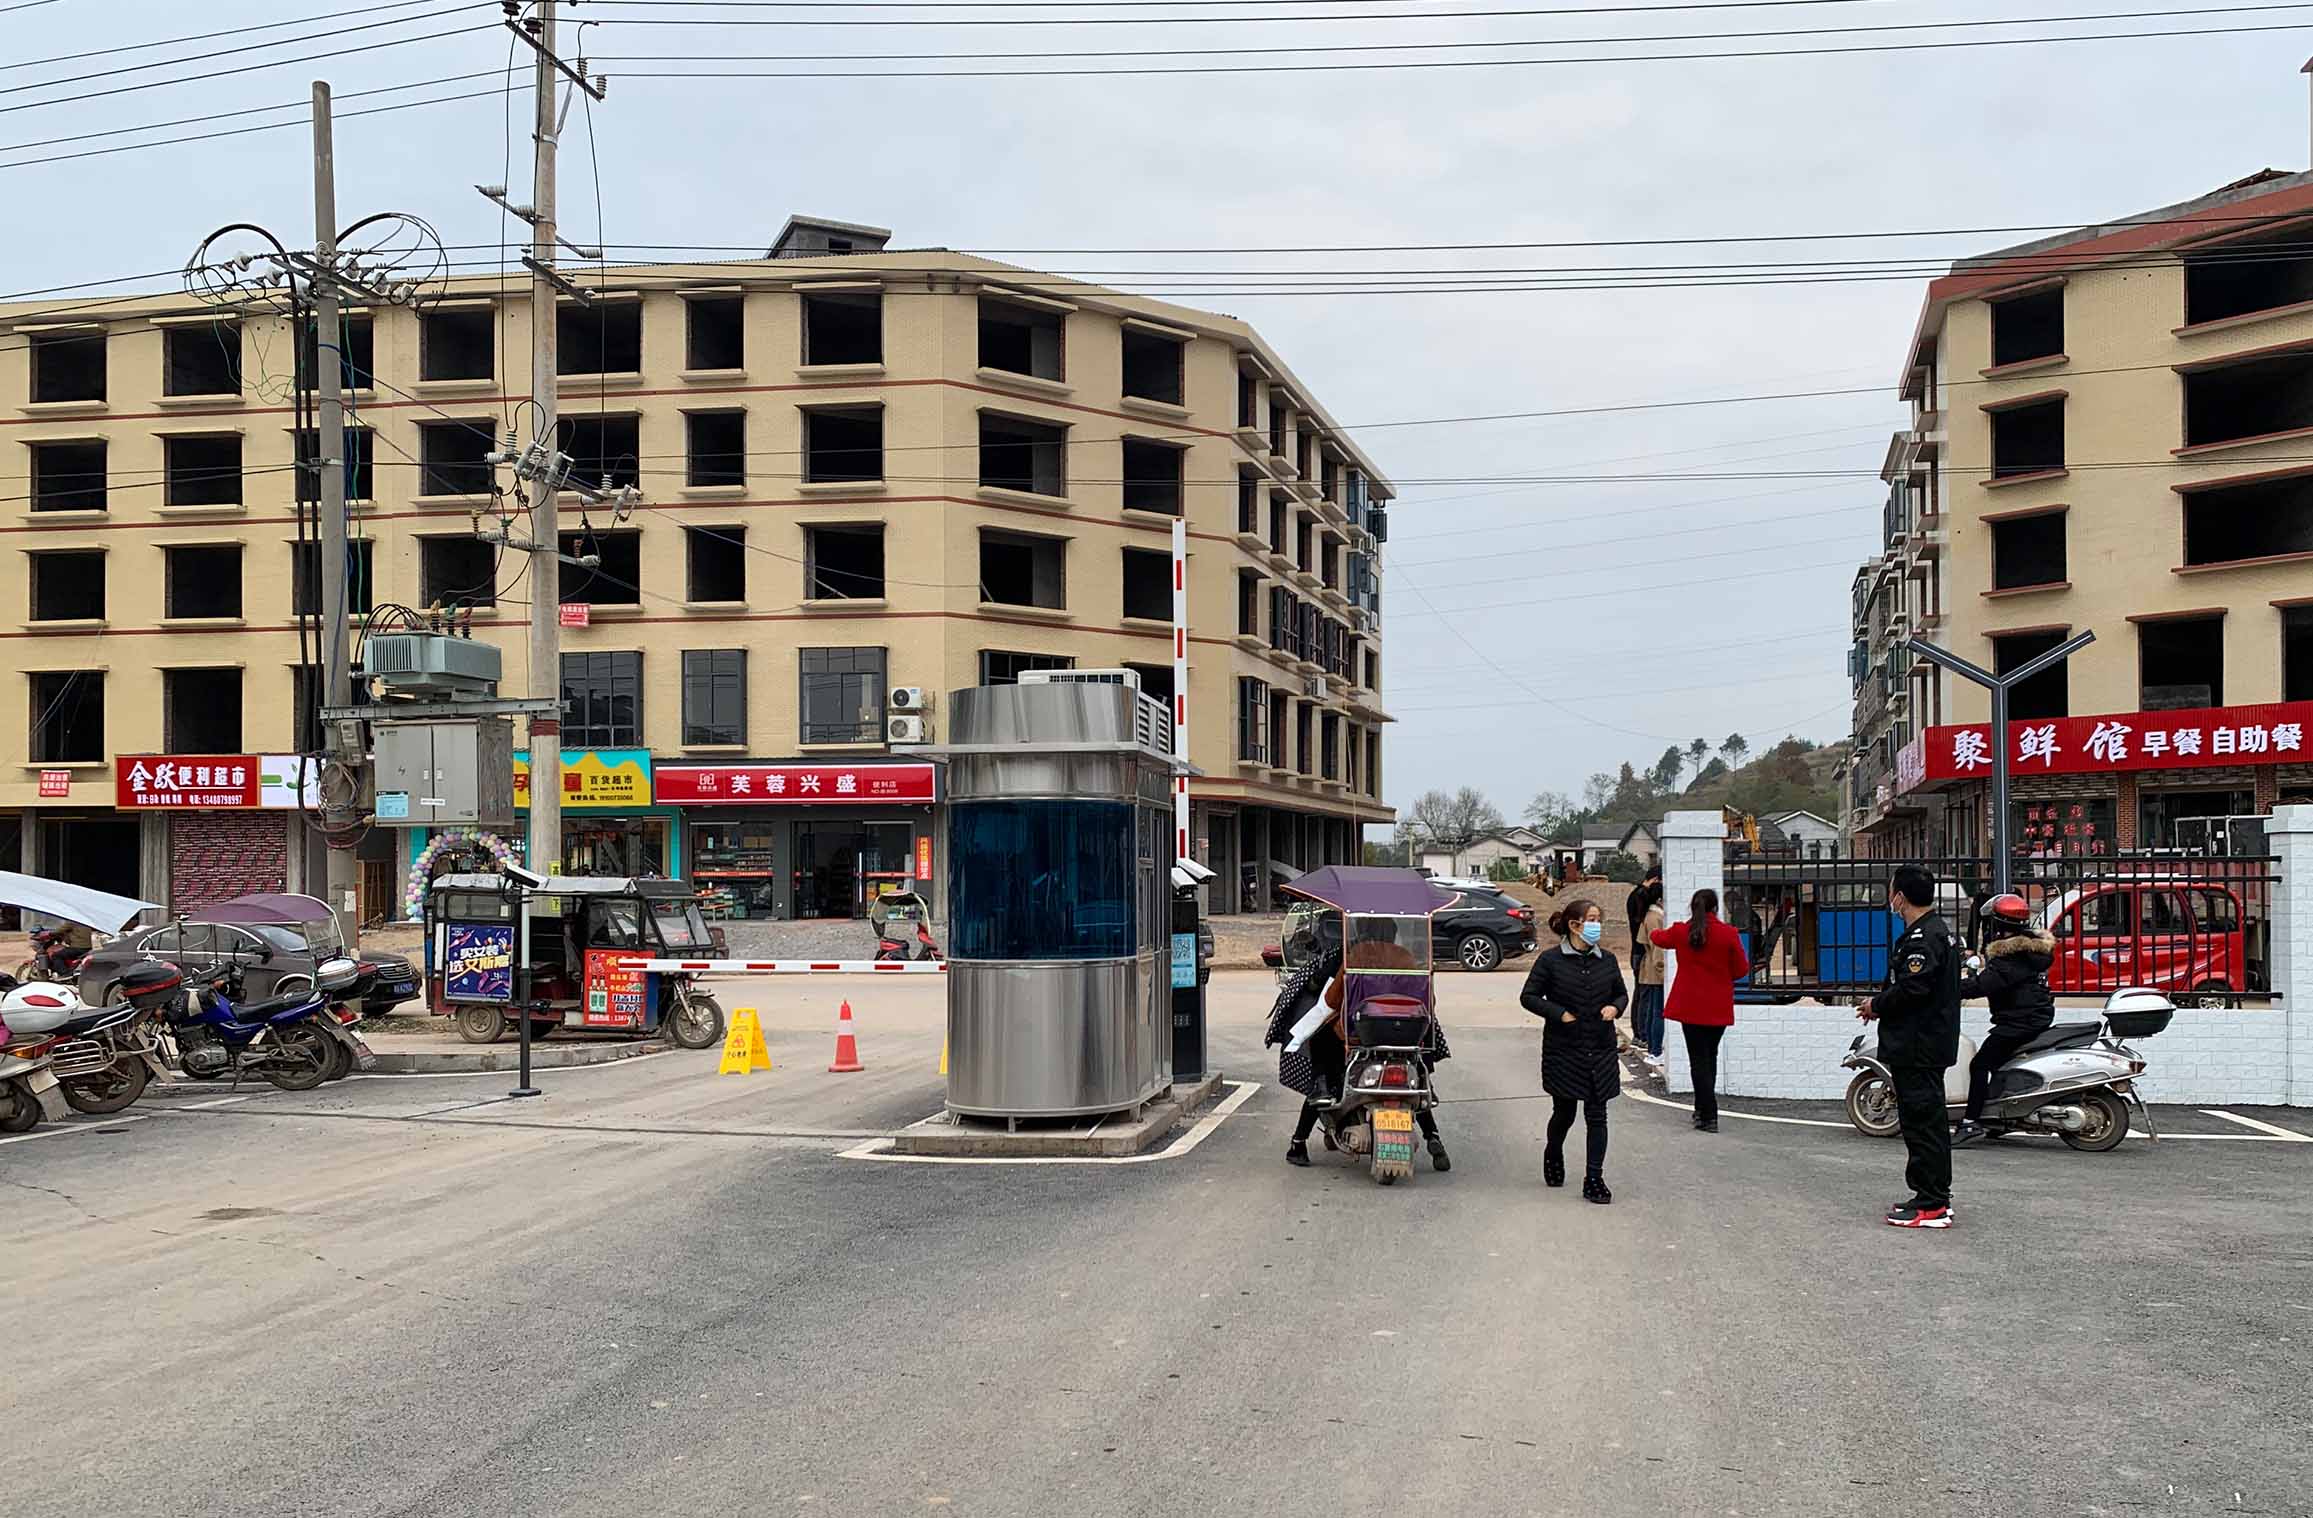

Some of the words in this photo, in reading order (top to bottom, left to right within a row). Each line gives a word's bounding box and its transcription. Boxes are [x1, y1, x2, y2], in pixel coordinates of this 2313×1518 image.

[1952, 722, 2133, 771] 聚鲜馆
[2141, 729, 2202, 758] 早餐
[2212, 722, 2303, 756] 自助餐
[590, 774, 633, 785] 百货超市
[731, 774, 857, 794] 芙蓉兴盛
